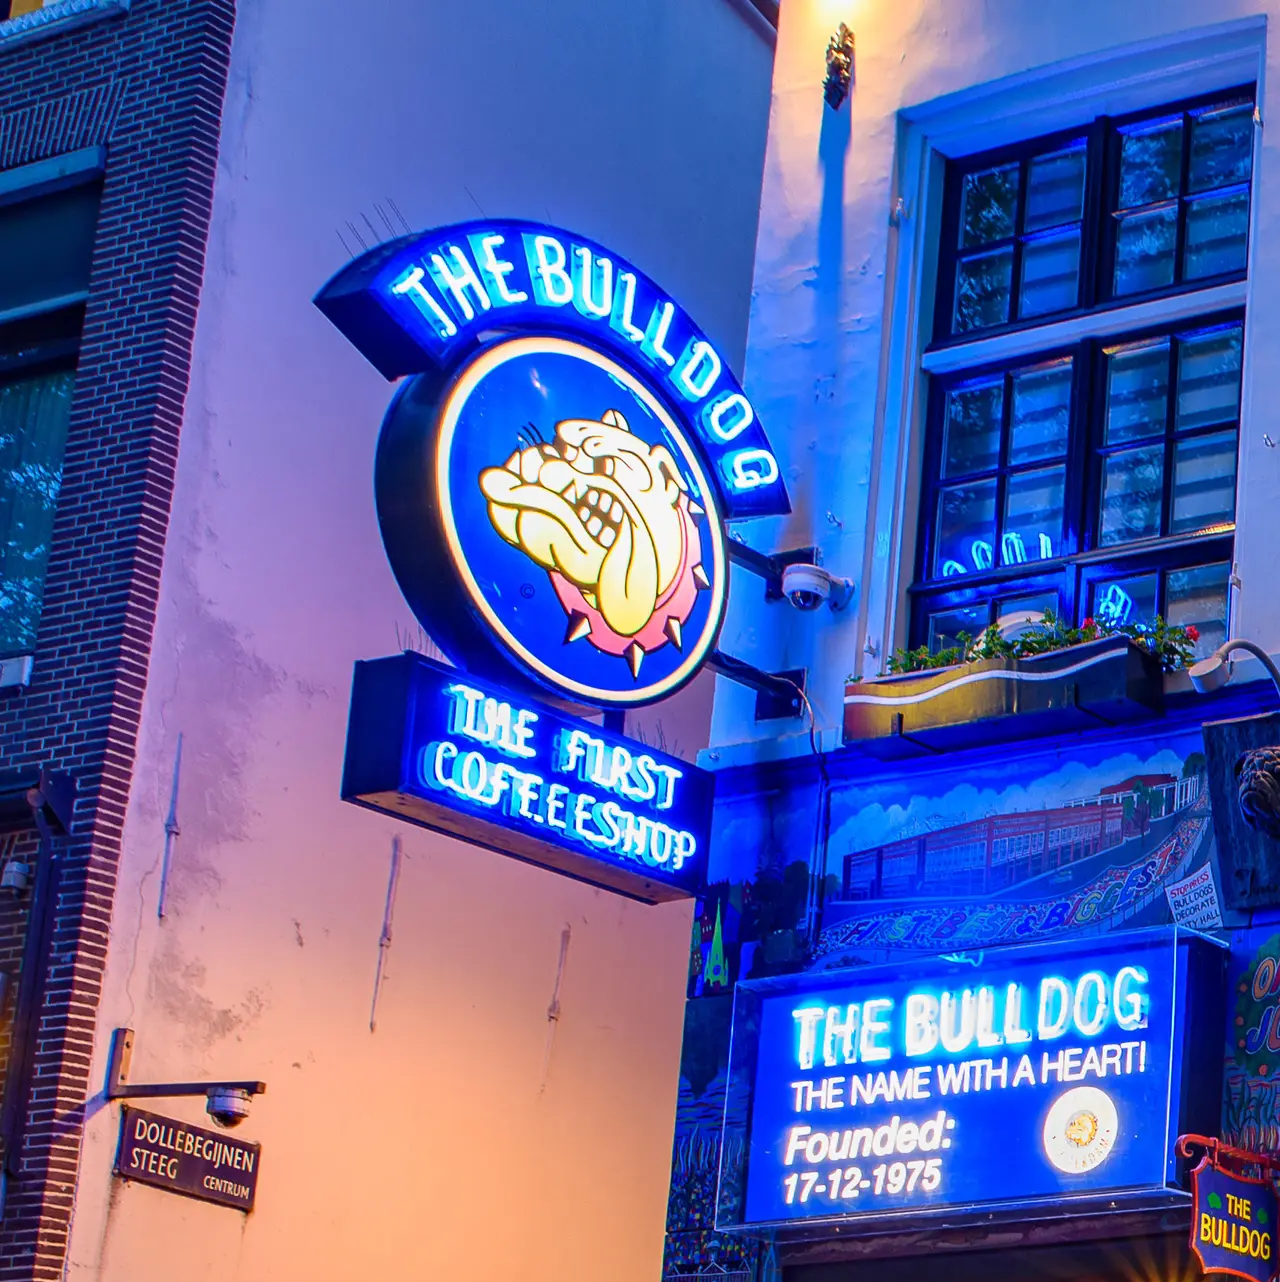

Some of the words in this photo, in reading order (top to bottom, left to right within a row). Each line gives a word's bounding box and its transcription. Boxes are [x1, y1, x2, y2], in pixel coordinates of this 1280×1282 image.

[392, 233, 528, 338] THE
[522, 233, 780, 491] BULLDOG
[445, 683, 539, 758] THE
[555, 728, 684, 810] FIRST
[839, 912, 926, 946] FIRST
[933, 911, 1025, 941] BEST
[1040, 840, 1178, 931] BIGGEST
[1169, 883, 1189, 899] STOP
[1189, 870, 1210, 891] PRESS
[1173, 883, 1214, 911] BULLDOGS
[1175, 895, 1217, 922] DECORATE
[1199, 908, 1220, 925] HALL
[790, 996, 893, 1071] THE
[904, 965, 1150, 1057] BULLDOG
[791, 1077, 844, 1114] THE
[850, 1068, 934, 1108] NAME
[937, 1056, 1009, 1096] WITH
[1012, 1053, 1036, 1087] A
[1040, 1040, 1147, 1086] HEART!
[133, 1117, 255, 1174] DOLLEBEGIJNEN
[785, 1110, 957, 1165] Founded:
[130, 1147, 180, 1180] STEEG
[202, 1174, 251, 1201] CENTRUM
[783, 1157, 943, 1206] 17-12-1975
[1225, 1192, 1252, 1223] THE
[1199, 1213, 1272, 1261] BULLDOG
